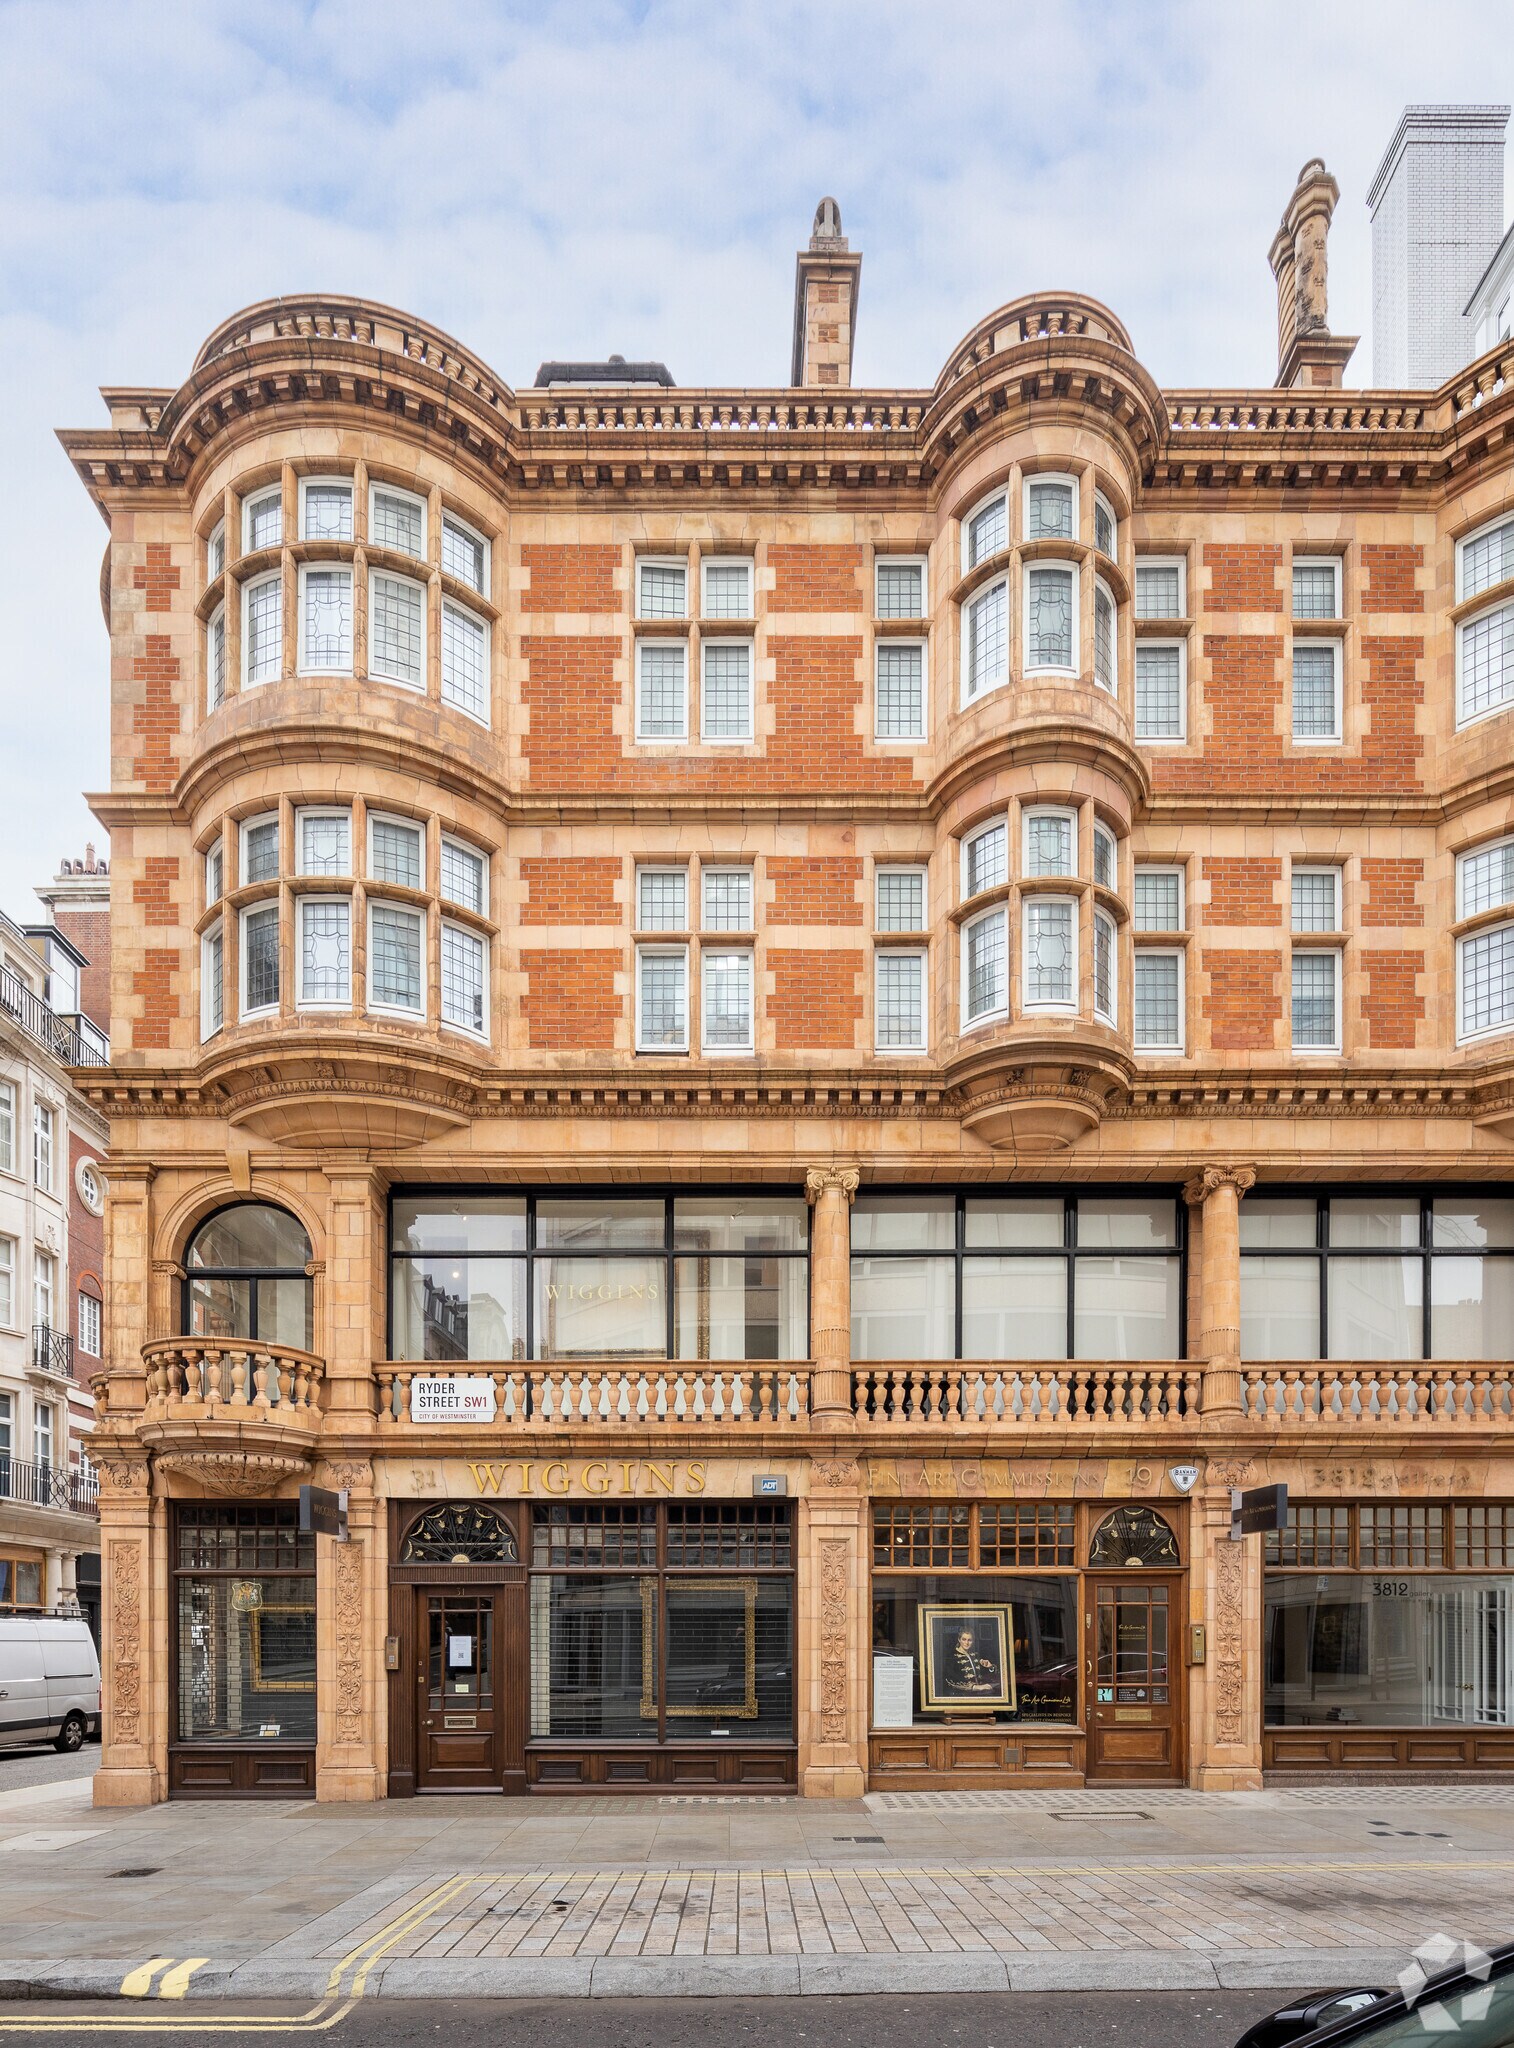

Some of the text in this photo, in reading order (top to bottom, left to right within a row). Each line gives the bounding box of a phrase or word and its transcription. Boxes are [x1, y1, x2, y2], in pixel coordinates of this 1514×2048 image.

[544, 1284, 658, 1300] WIGGINS
[419, 1383, 455, 1394] RYDER
[419, 1396, 487, 1408] STREET SW1
[467, 1462, 706, 1493] WIGGINS
[868, 1468, 1099, 1486] FINE ART COMMISSIONS
[1125, 1467, 1152, 1487] 19
[1314, 1467, 1375, 1489] 3812
[762, 1481, 777, 1490] ADT
[313, 1504, 337, 1518] WIGGINS
[1372, 1582, 1408, 1596] 3812
